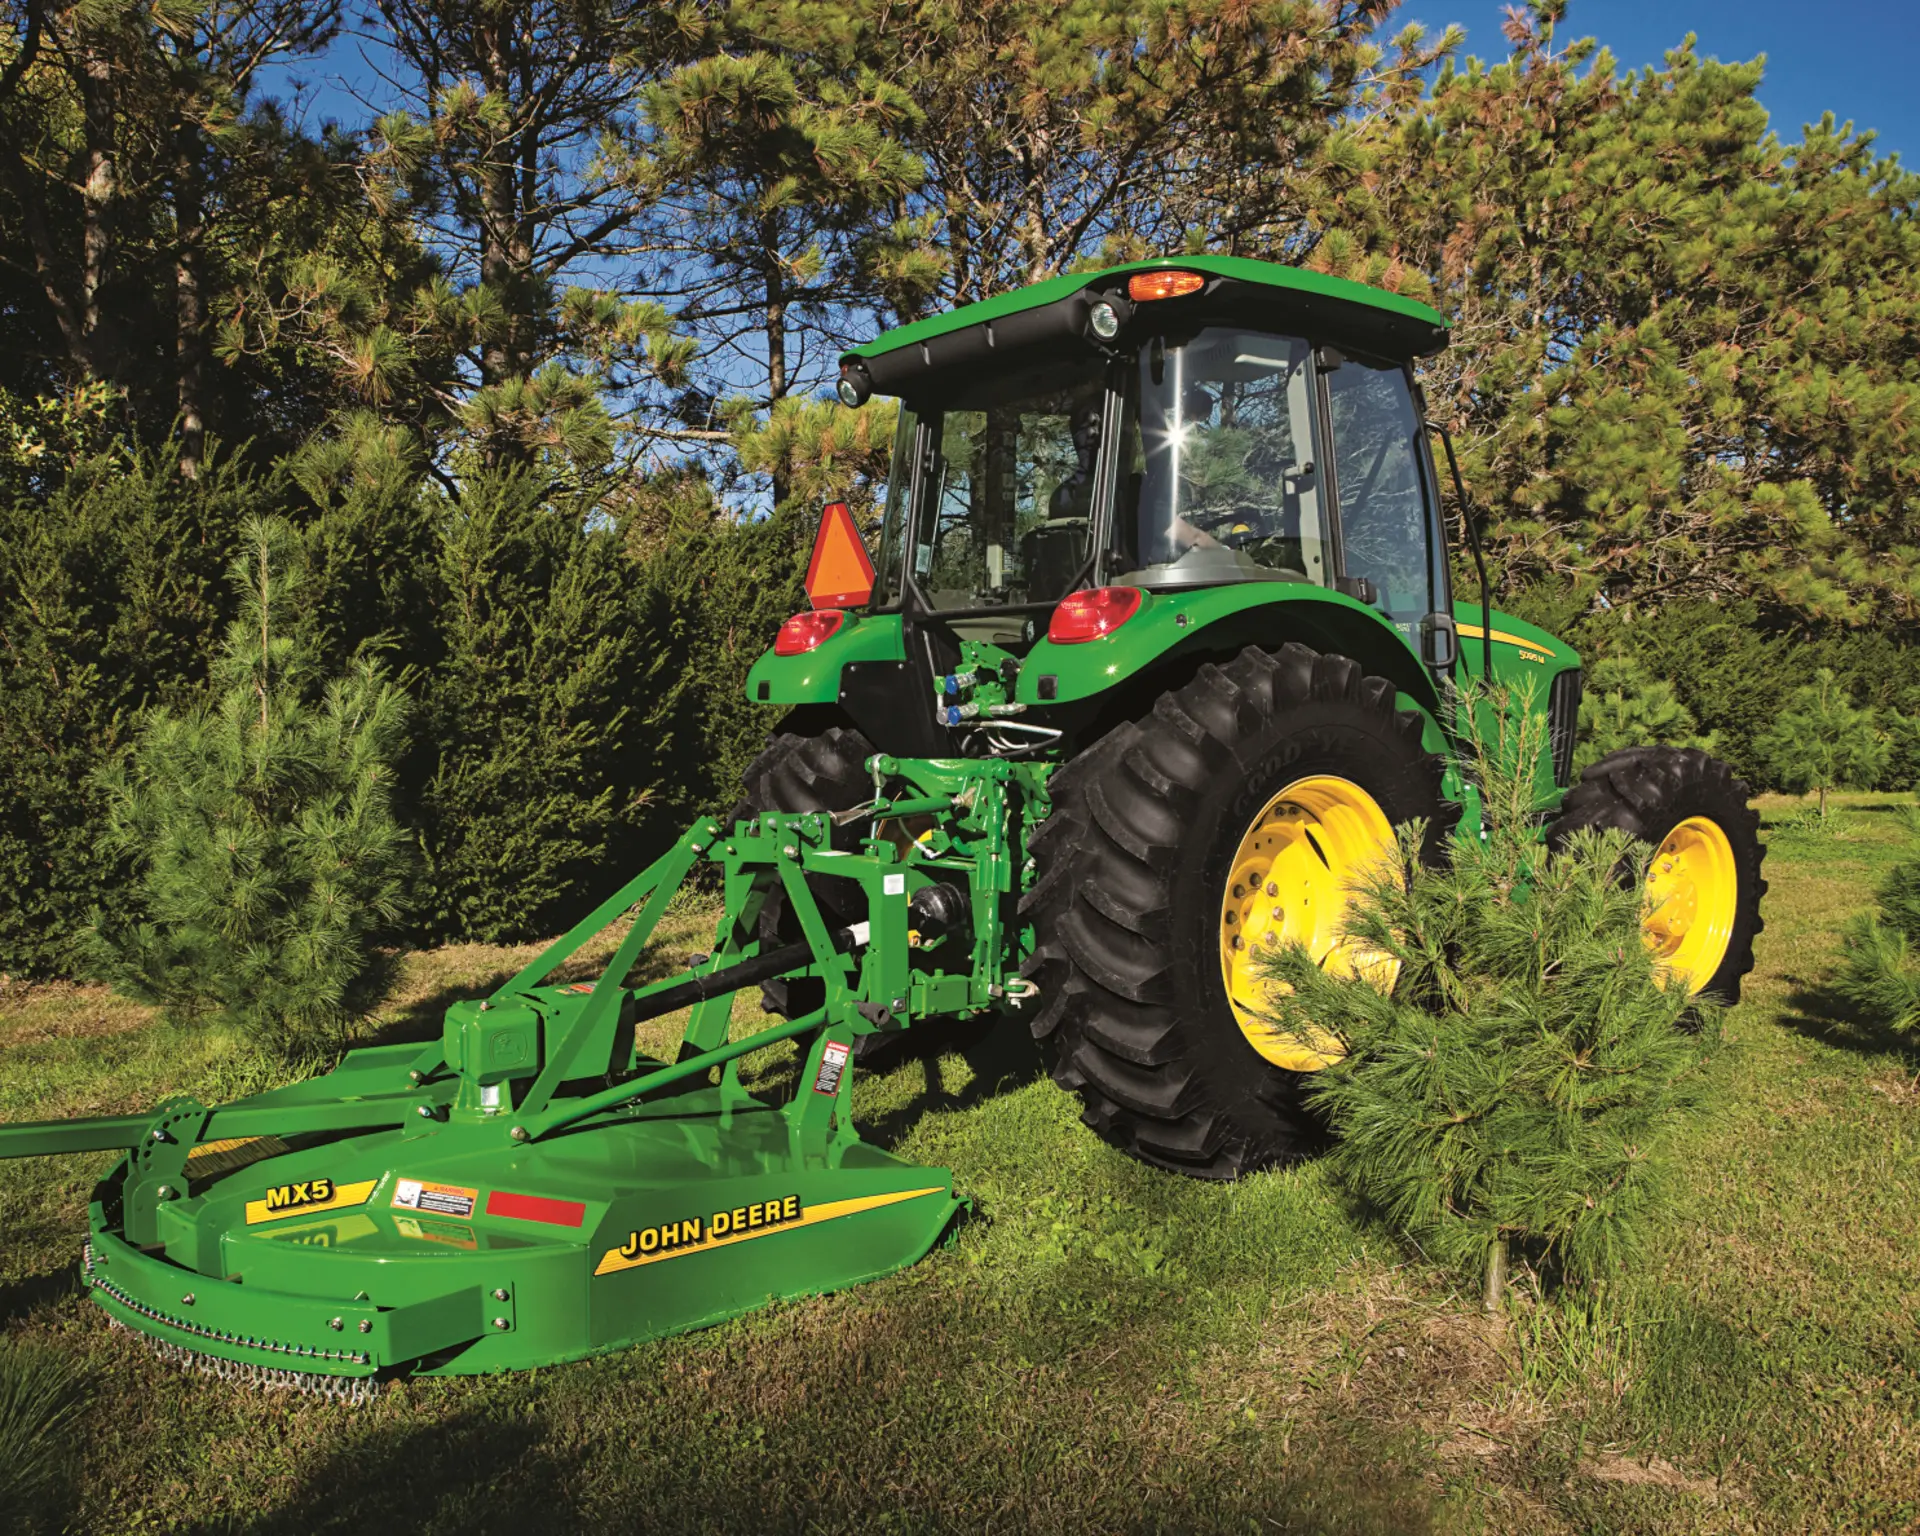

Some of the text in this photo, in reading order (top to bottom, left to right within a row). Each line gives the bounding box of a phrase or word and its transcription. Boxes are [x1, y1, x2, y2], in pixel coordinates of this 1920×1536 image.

[266, 1178, 332, 1209] MX5
[620, 1194, 799, 1257] JOHN DEERE
